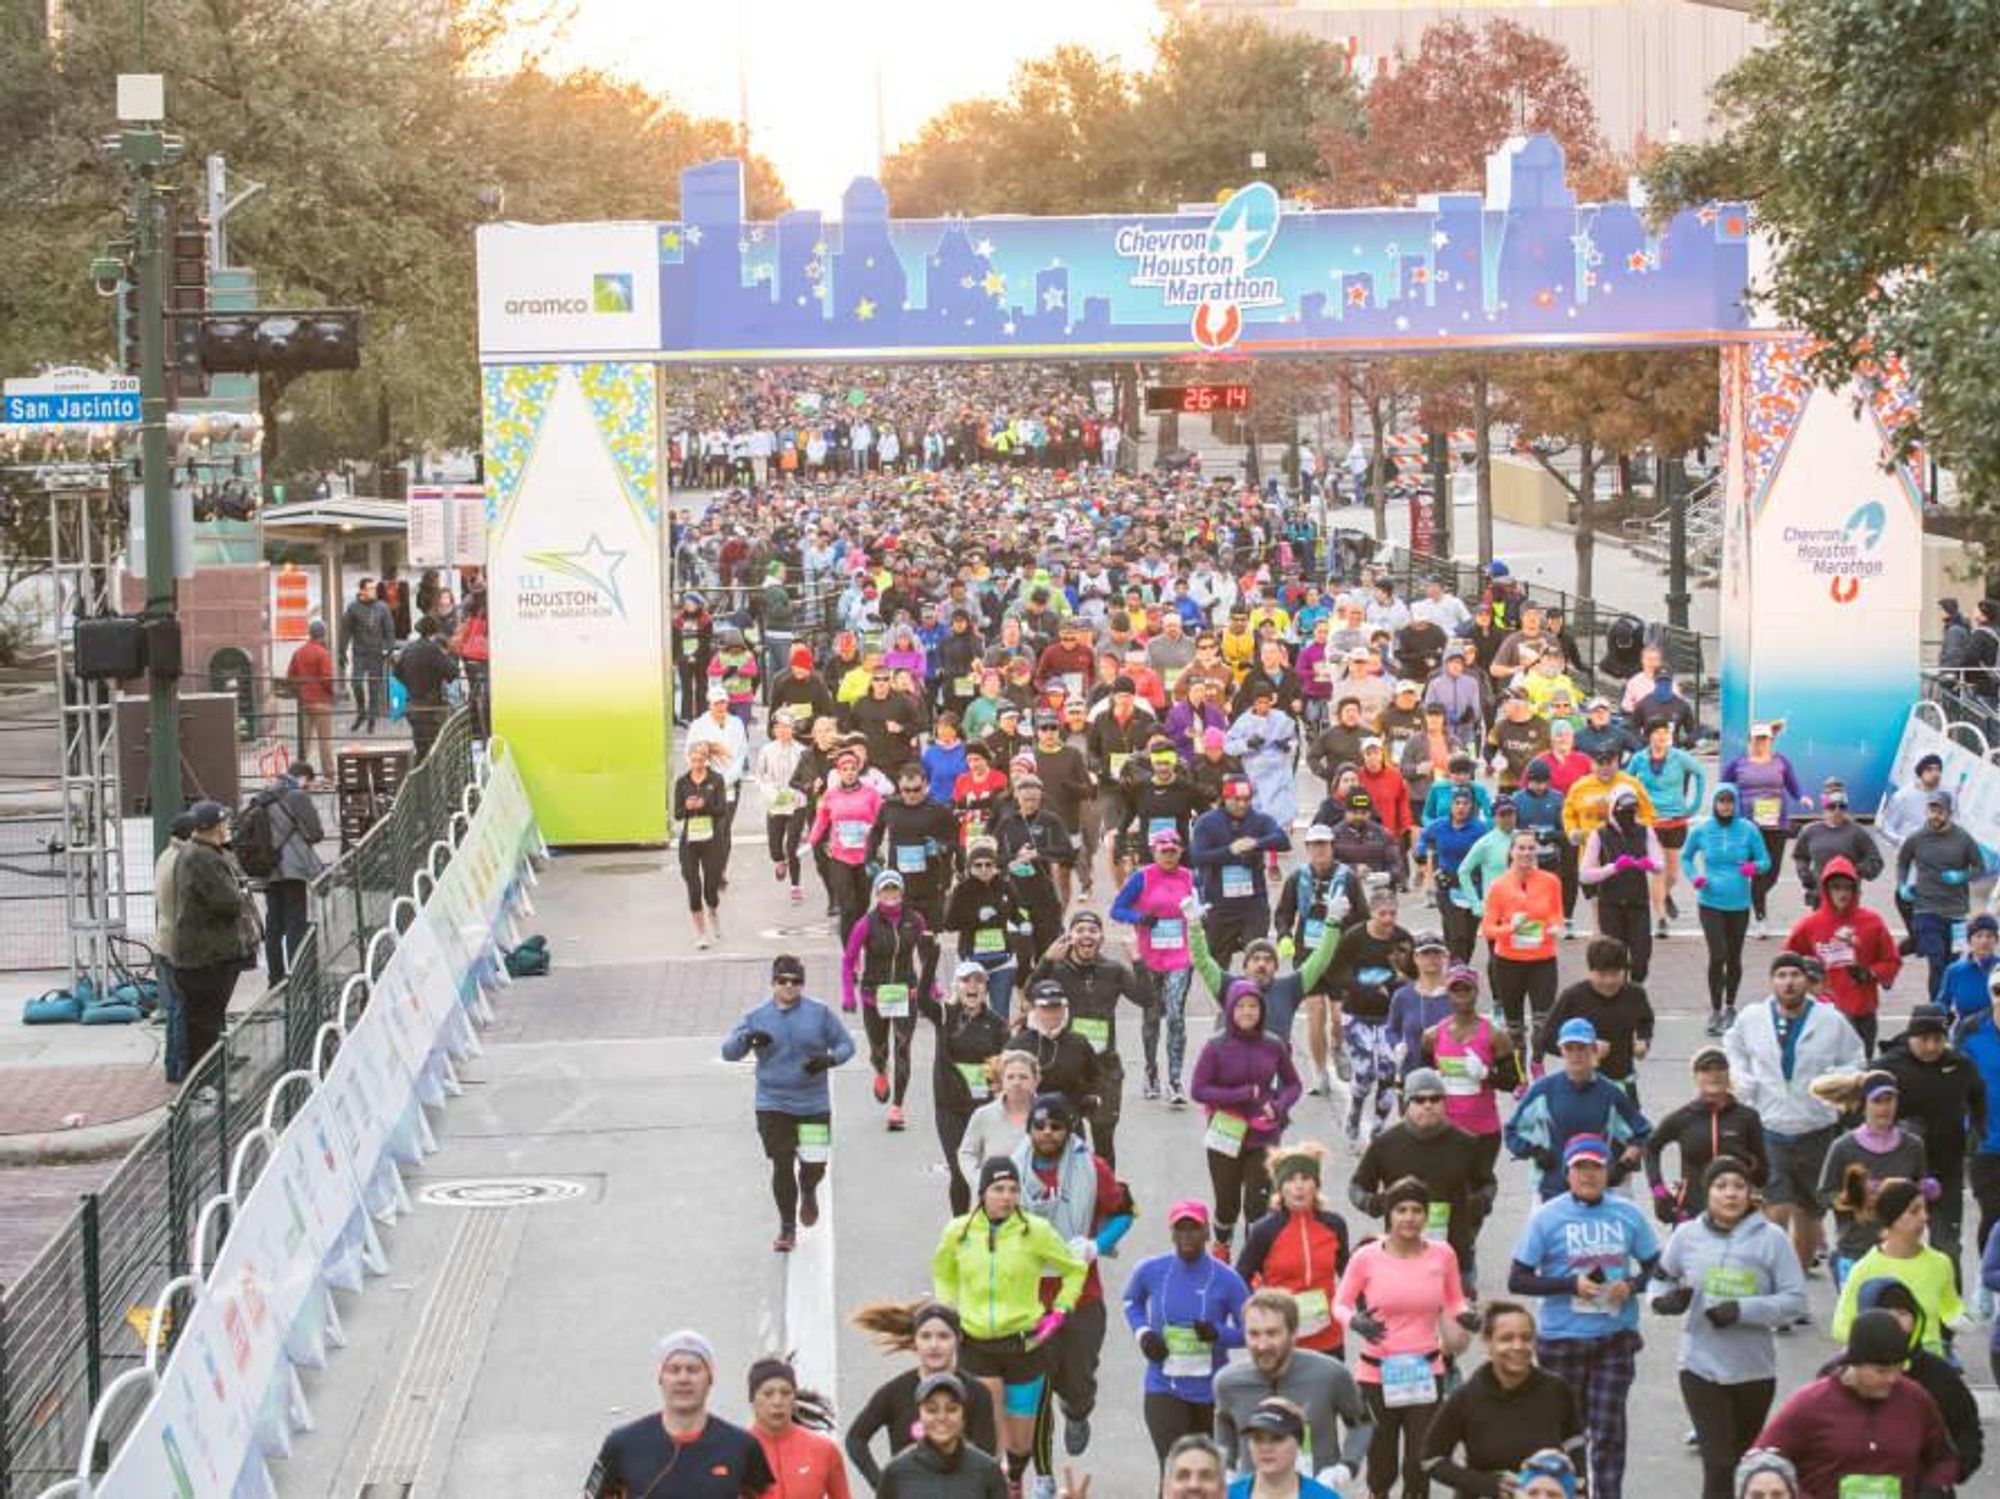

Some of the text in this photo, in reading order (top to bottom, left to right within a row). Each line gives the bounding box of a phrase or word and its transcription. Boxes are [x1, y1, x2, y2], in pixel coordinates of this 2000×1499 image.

[1119, 229, 1206, 253] Chevron
[1142, 252, 1234, 277] Houston
[1168, 277, 1275, 301] Marathon
[505, 299, 588, 315] aramco
[10, 396, 134, 419] San Jacinto
[1783, 526, 1840, 542] Chevron
[1797, 543, 1858, 558] Houston
[1814, 559, 1883, 575] Marathon
[518, 591, 598, 607] HOUSTON
[1566, 1221, 1623, 1248] RUN
